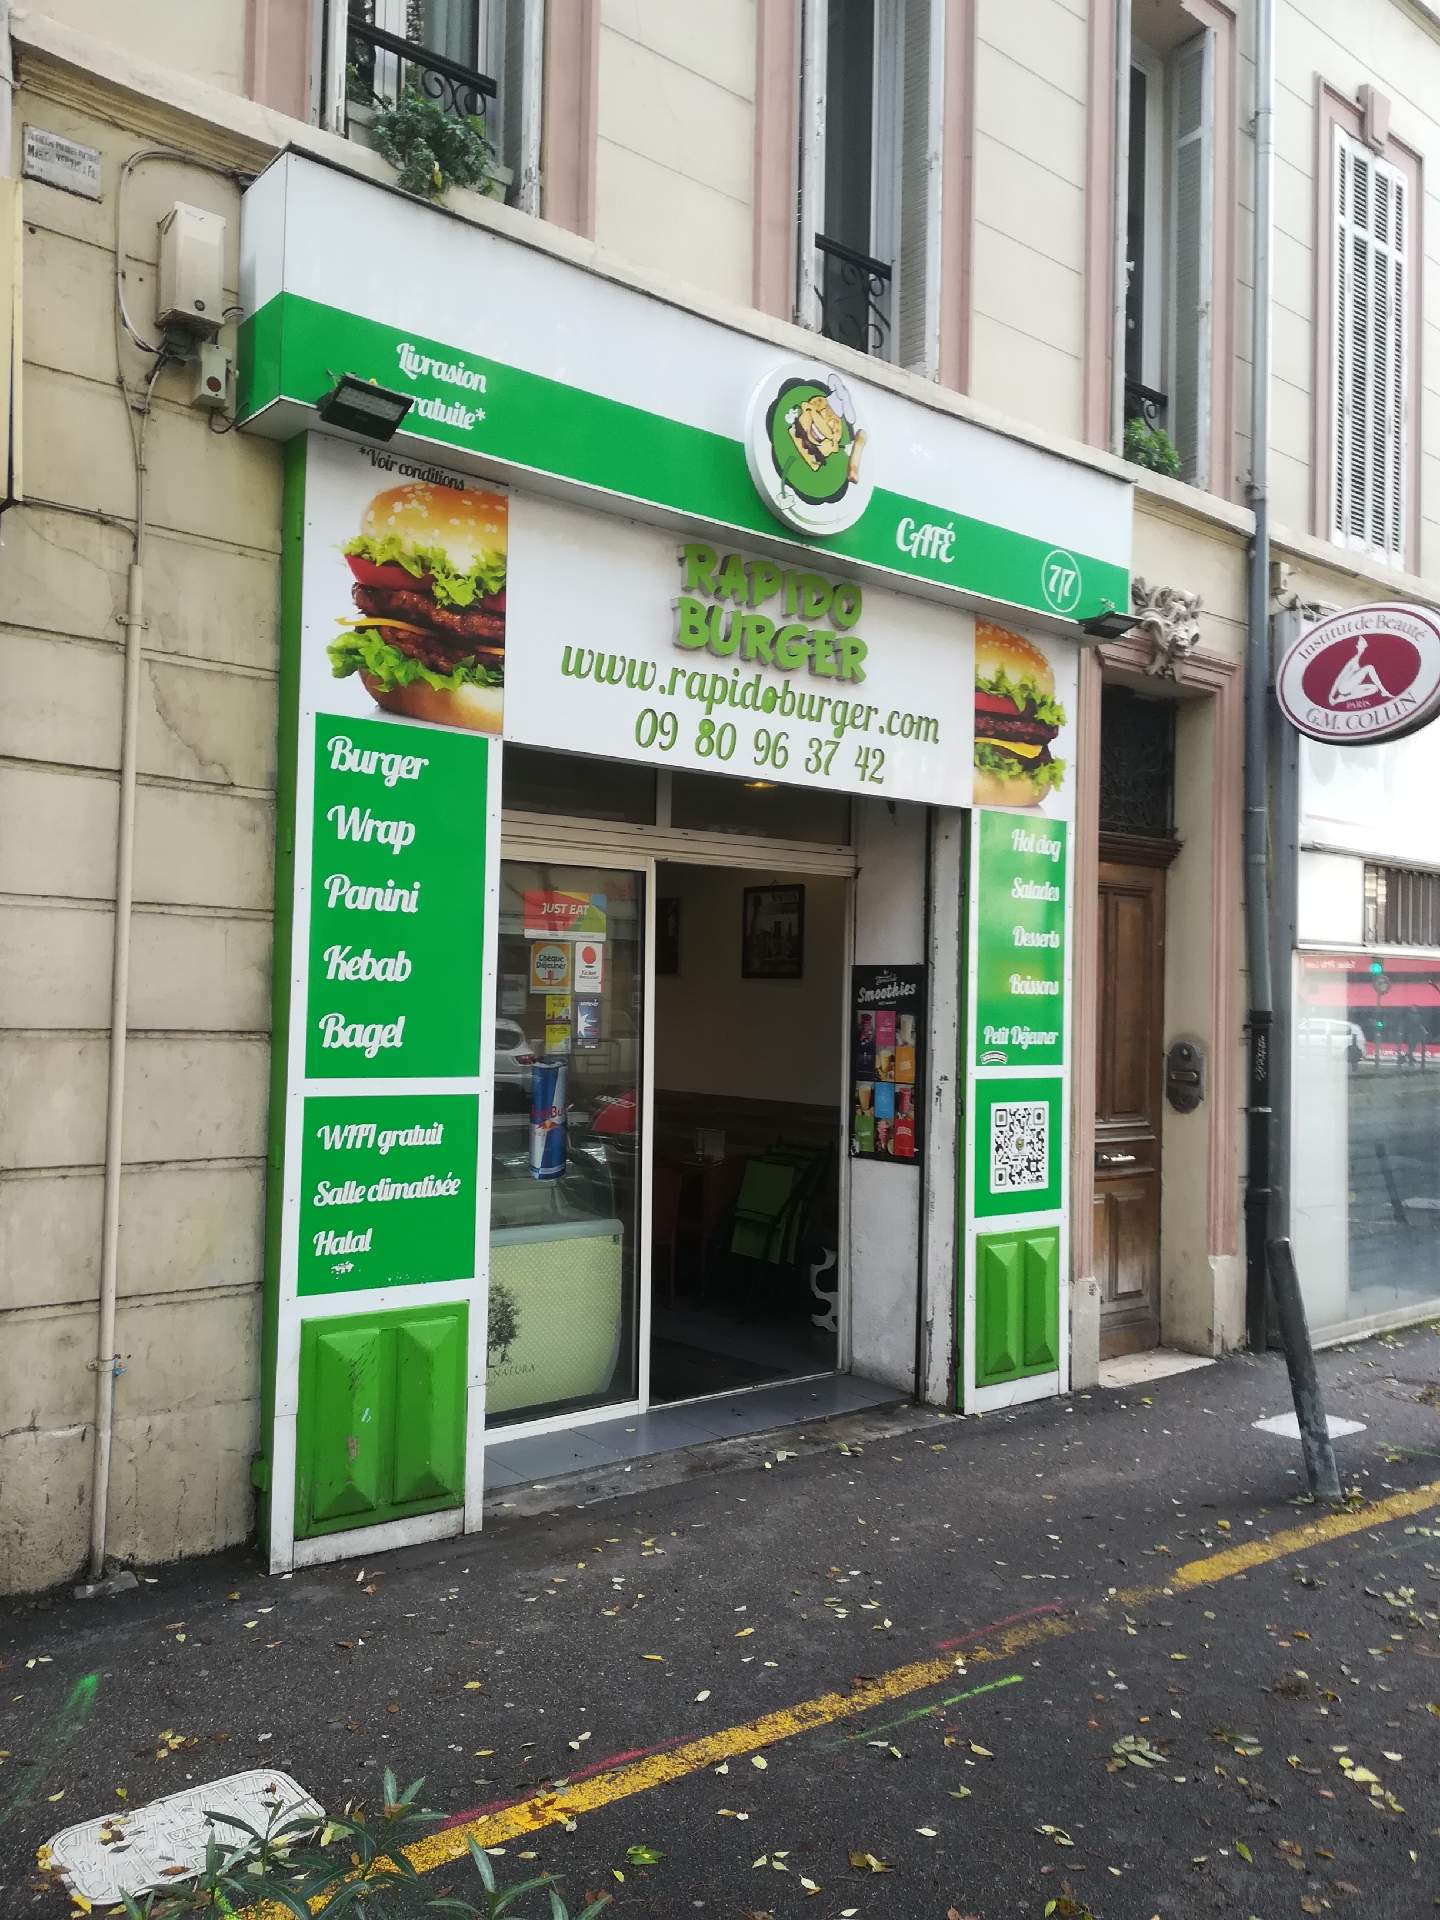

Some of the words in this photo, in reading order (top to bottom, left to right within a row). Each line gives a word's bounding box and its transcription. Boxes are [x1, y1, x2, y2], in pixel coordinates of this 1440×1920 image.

[408, 397, 486, 430] ratuite
[398, 463, 465, 491] conditions
[676, 543, 863, 630] RAPIDO
[672, 596, 869, 684] BURGER
[1298, 622, 1353, 661] Institut
[1354, 615, 1375, 632] de
[1376, 614, 1429, 643] Beauté
[560, 645, 940, 745] www.rapidoburger.com
[1346, 690, 1417, 730] COLLIN
[327, 735, 429, 787] Burger
[634, 708, 679, 752] 09
[694, 718, 738, 761] 80
[752, 728, 790, 769] 96
[804, 737, 841, 776] 37
[854, 744, 886, 785] 42
[327, 805, 416, 855] Wrap
[1011, 828, 1035, 852] Hot
[1035, 834, 1062, 863] dog
[324, 874, 421, 913] Panini
[1011, 877, 1060, 901] Salades
[541, 902, 568, 915] JUST
[568, 904, 589, 915] EAT
[1013, 925, 1060, 948] Desserts
[323, 945, 412, 982] Kebab
[857, 981, 917, 1003] Smoothies
[1009, 973, 1059, 995] Boissons
[319, 1012, 406, 1058] Bagel
[983, 1025, 1009, 1045] Petit
[316, 1123, 377, 1150] WIFI
[377, 1122, 445, 1155] gratuit
[313, 1180, 366, 1207] Salle
[367, 1171, 461, 1202] climatisée
[313, 1228, 373, 1256] Halal
